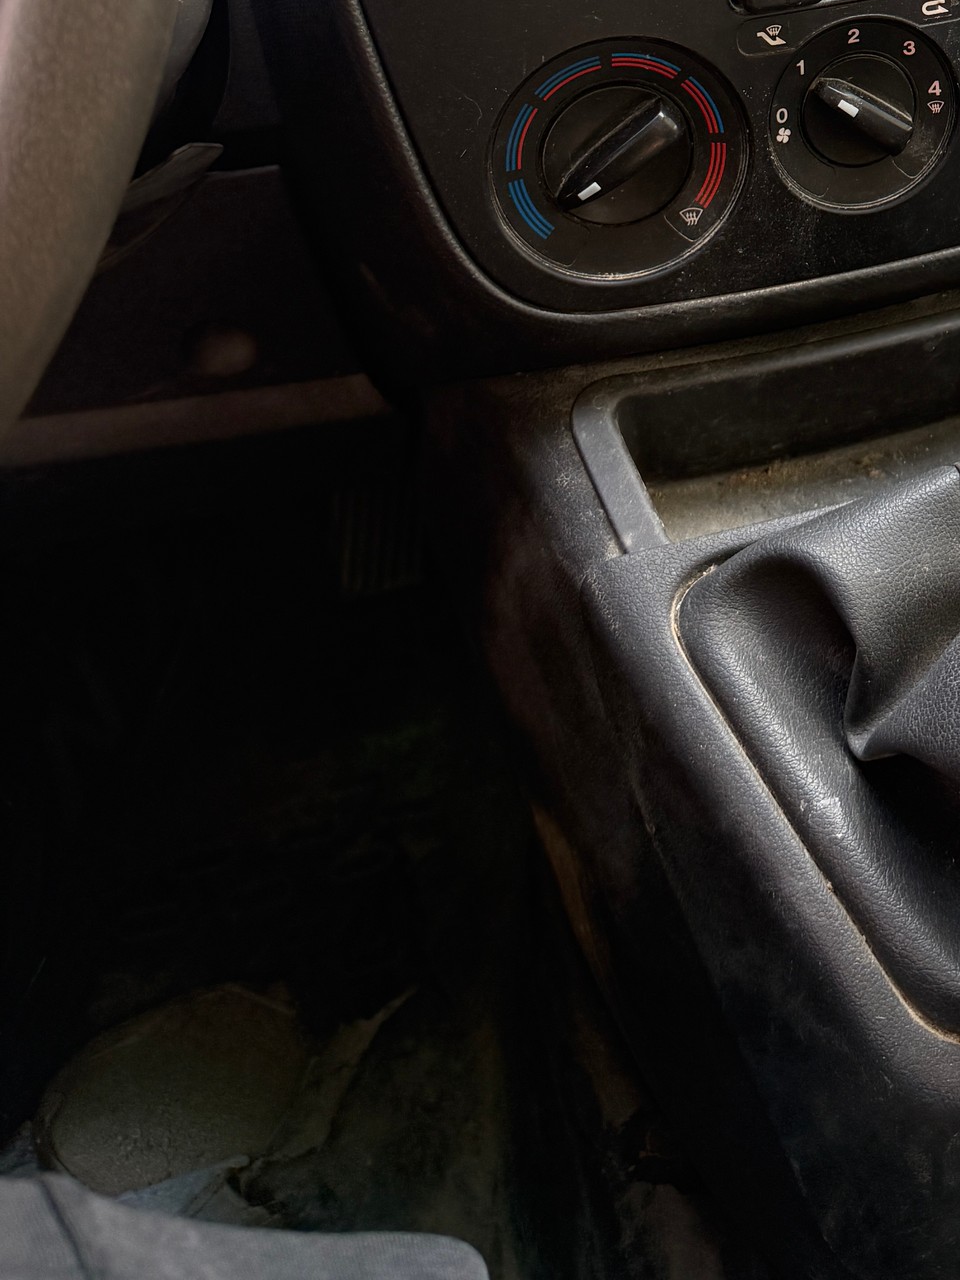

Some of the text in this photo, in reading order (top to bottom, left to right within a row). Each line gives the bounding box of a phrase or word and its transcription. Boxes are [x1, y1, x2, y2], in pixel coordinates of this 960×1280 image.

[847, 27, 860, 45] 2
[903, 40, 916, 57] 3
[796, 59, 806, 76] 1
[927, 80, 942, 97] 4
[775, 107, 788, 124] 0
